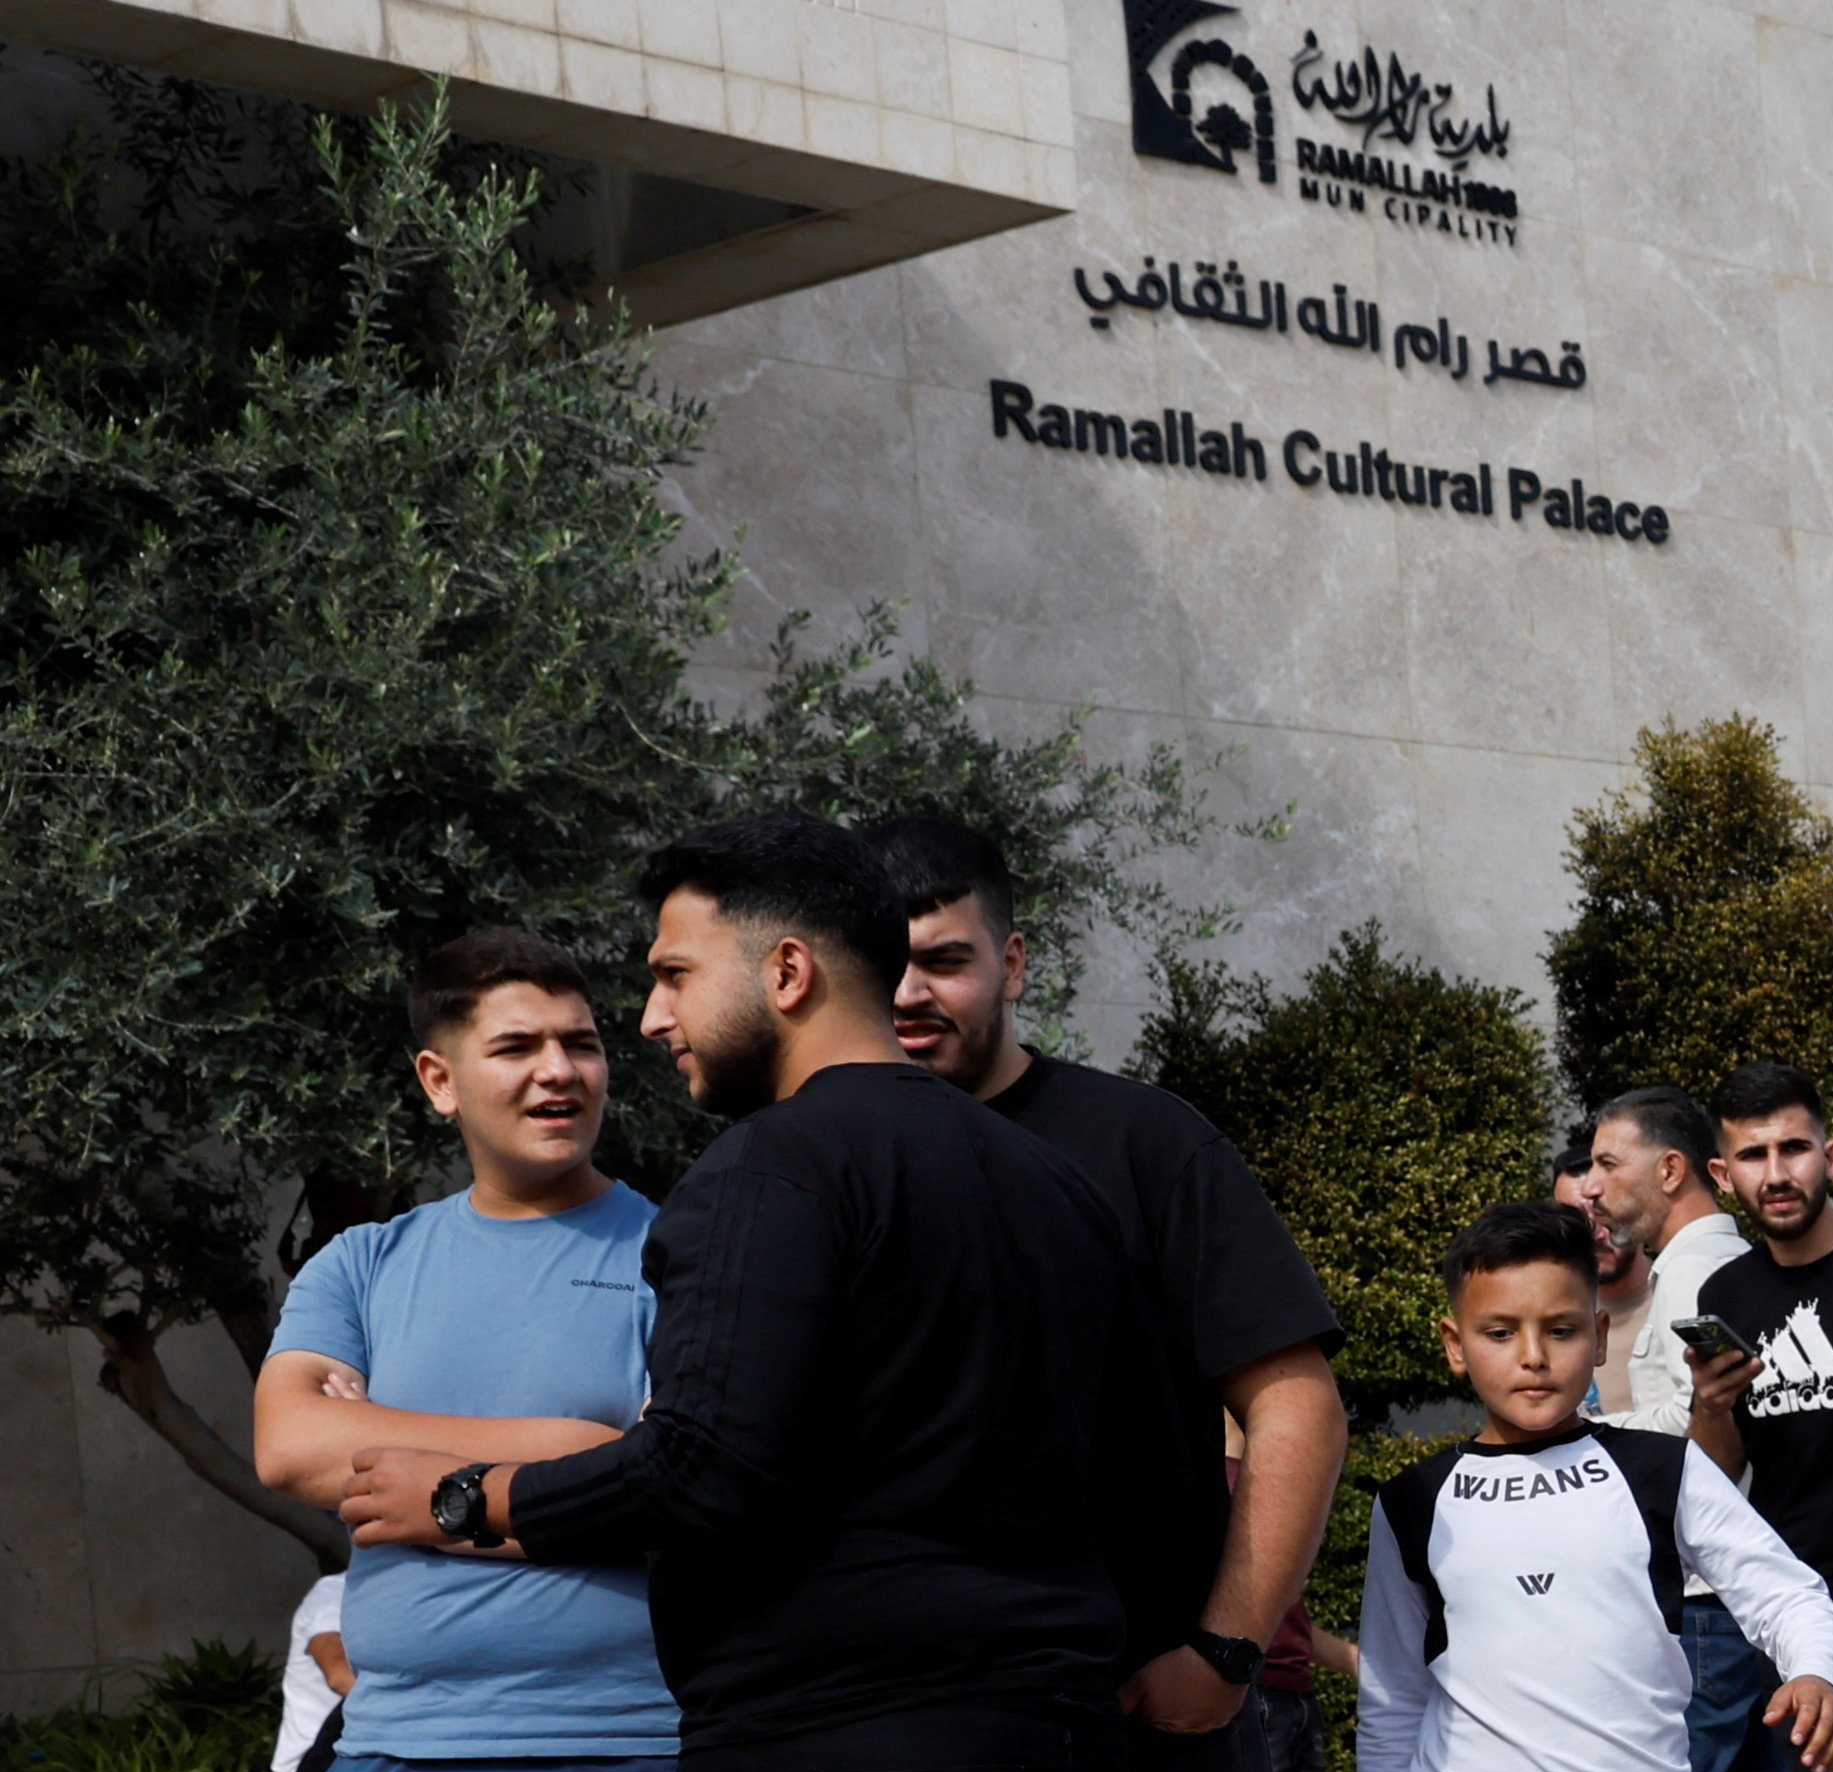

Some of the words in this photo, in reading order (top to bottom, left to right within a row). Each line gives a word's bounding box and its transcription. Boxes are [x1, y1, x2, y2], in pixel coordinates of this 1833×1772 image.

[1296, 138, 1462, 207] RAMALLAH
[1074, 256, 1288, 333] الثقافي
[1297, 283, 1380, 352] الله
[1394, 316, 1468, 380] رام
[1483, 340, 1586, 388] قصر
[990, 378, 1267, 480] Ramallah
[1283, 429, 1494, 516] Cultural
[1508, 467, 1670, 545] Palace
